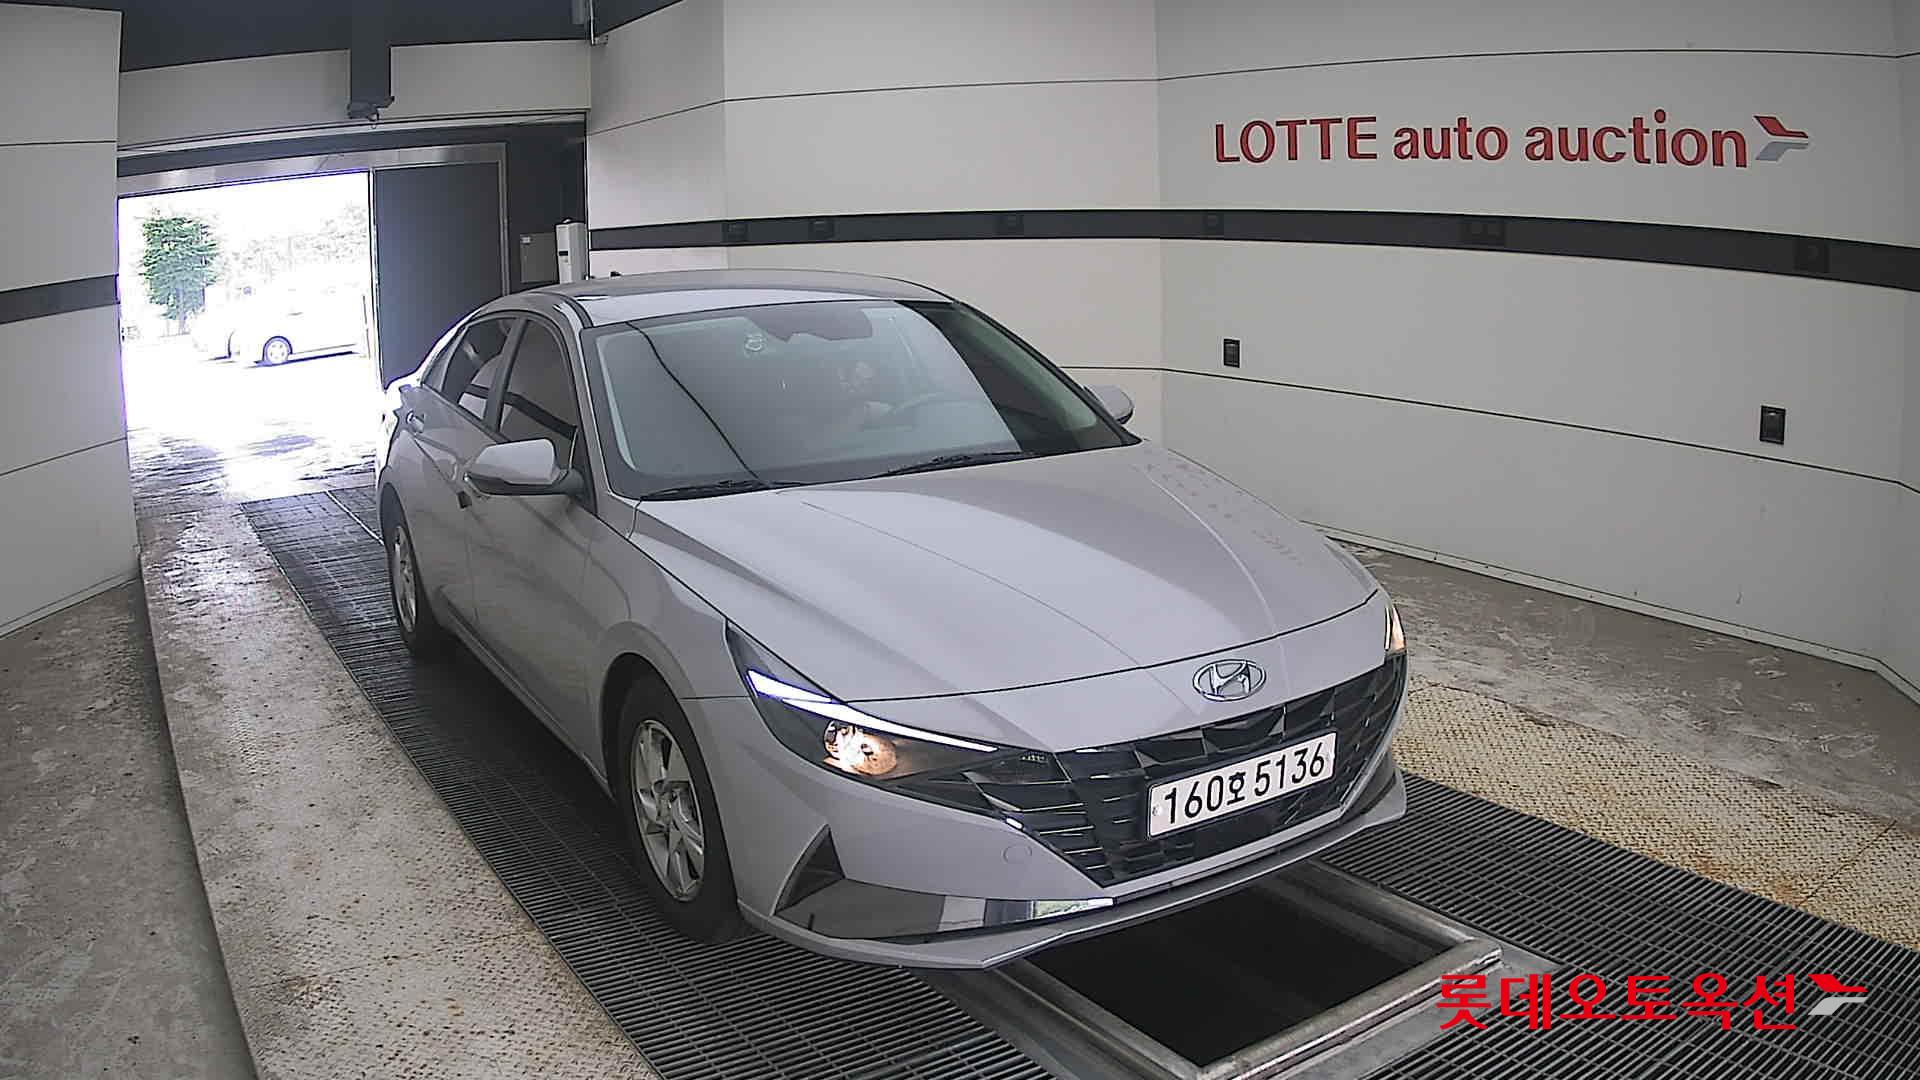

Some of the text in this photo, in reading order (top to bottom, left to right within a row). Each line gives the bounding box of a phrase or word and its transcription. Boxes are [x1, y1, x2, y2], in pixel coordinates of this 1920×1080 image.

[1215, 108, 1748, 169] LOTTE auto auction
[1253, 742, 1325, 797] 5136
